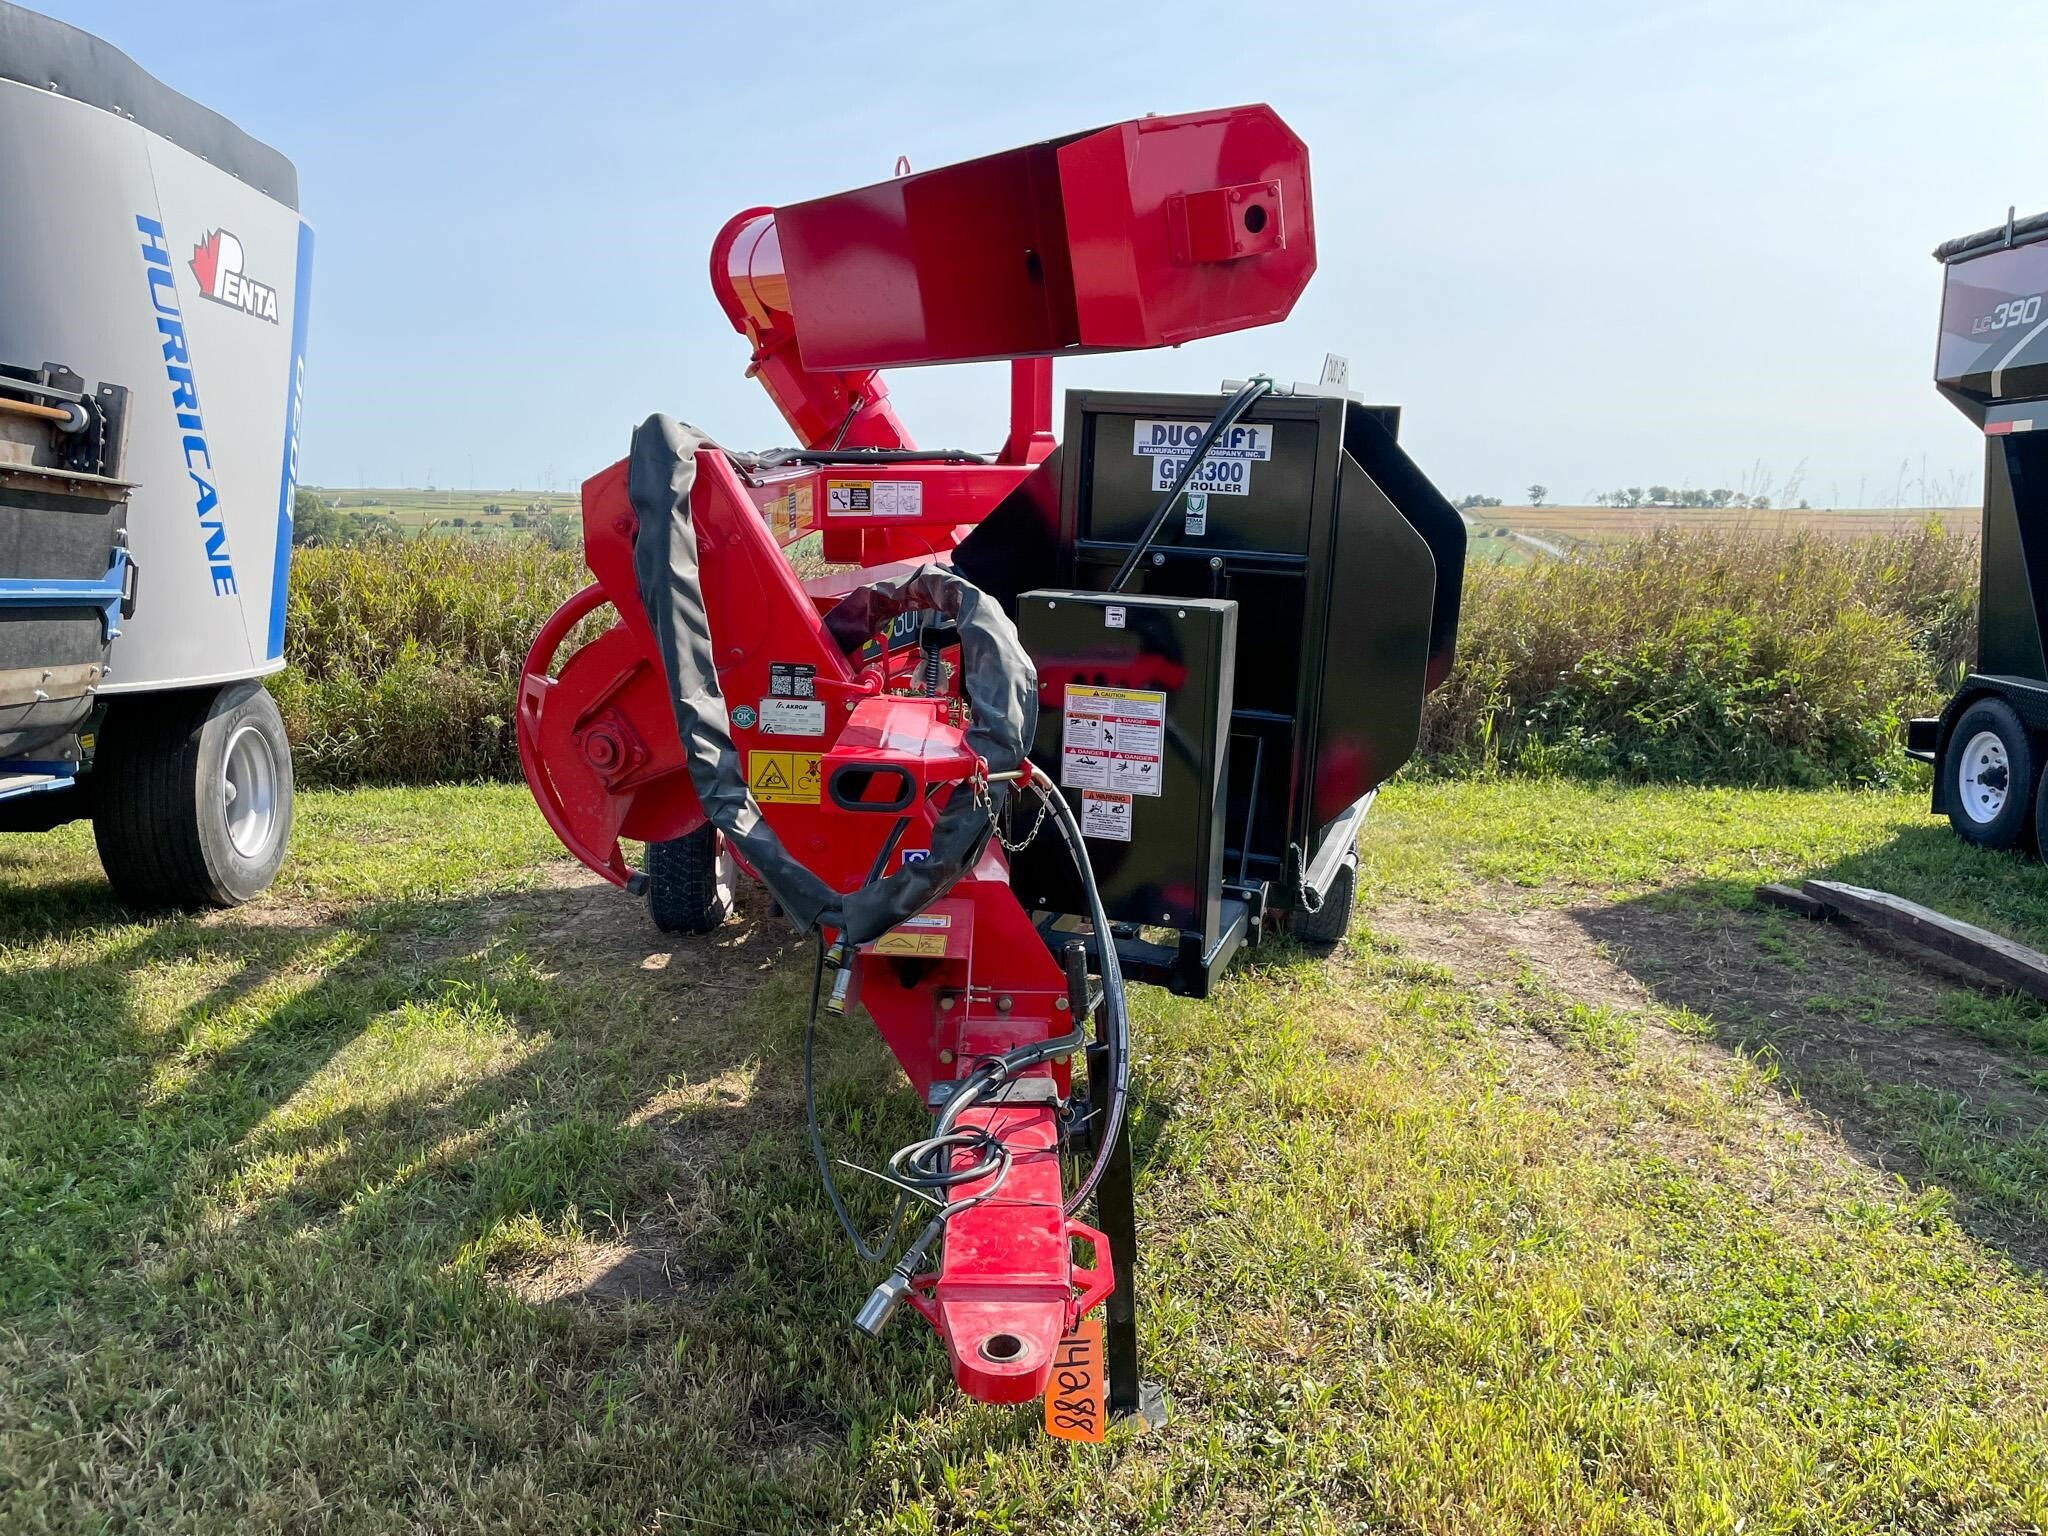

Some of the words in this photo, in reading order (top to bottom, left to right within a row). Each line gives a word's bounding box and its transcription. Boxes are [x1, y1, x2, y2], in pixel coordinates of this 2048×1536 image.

[213, 229, 279, 324] PENTA
[136, 214, 238, 597] HURRICANE
[286, 353, 304, 522] 5030
[1191, 482, 1241, 492] ROLLER
[736, 712, 750, 721] OK
[1095, 793, 1126, 801] WARNING
